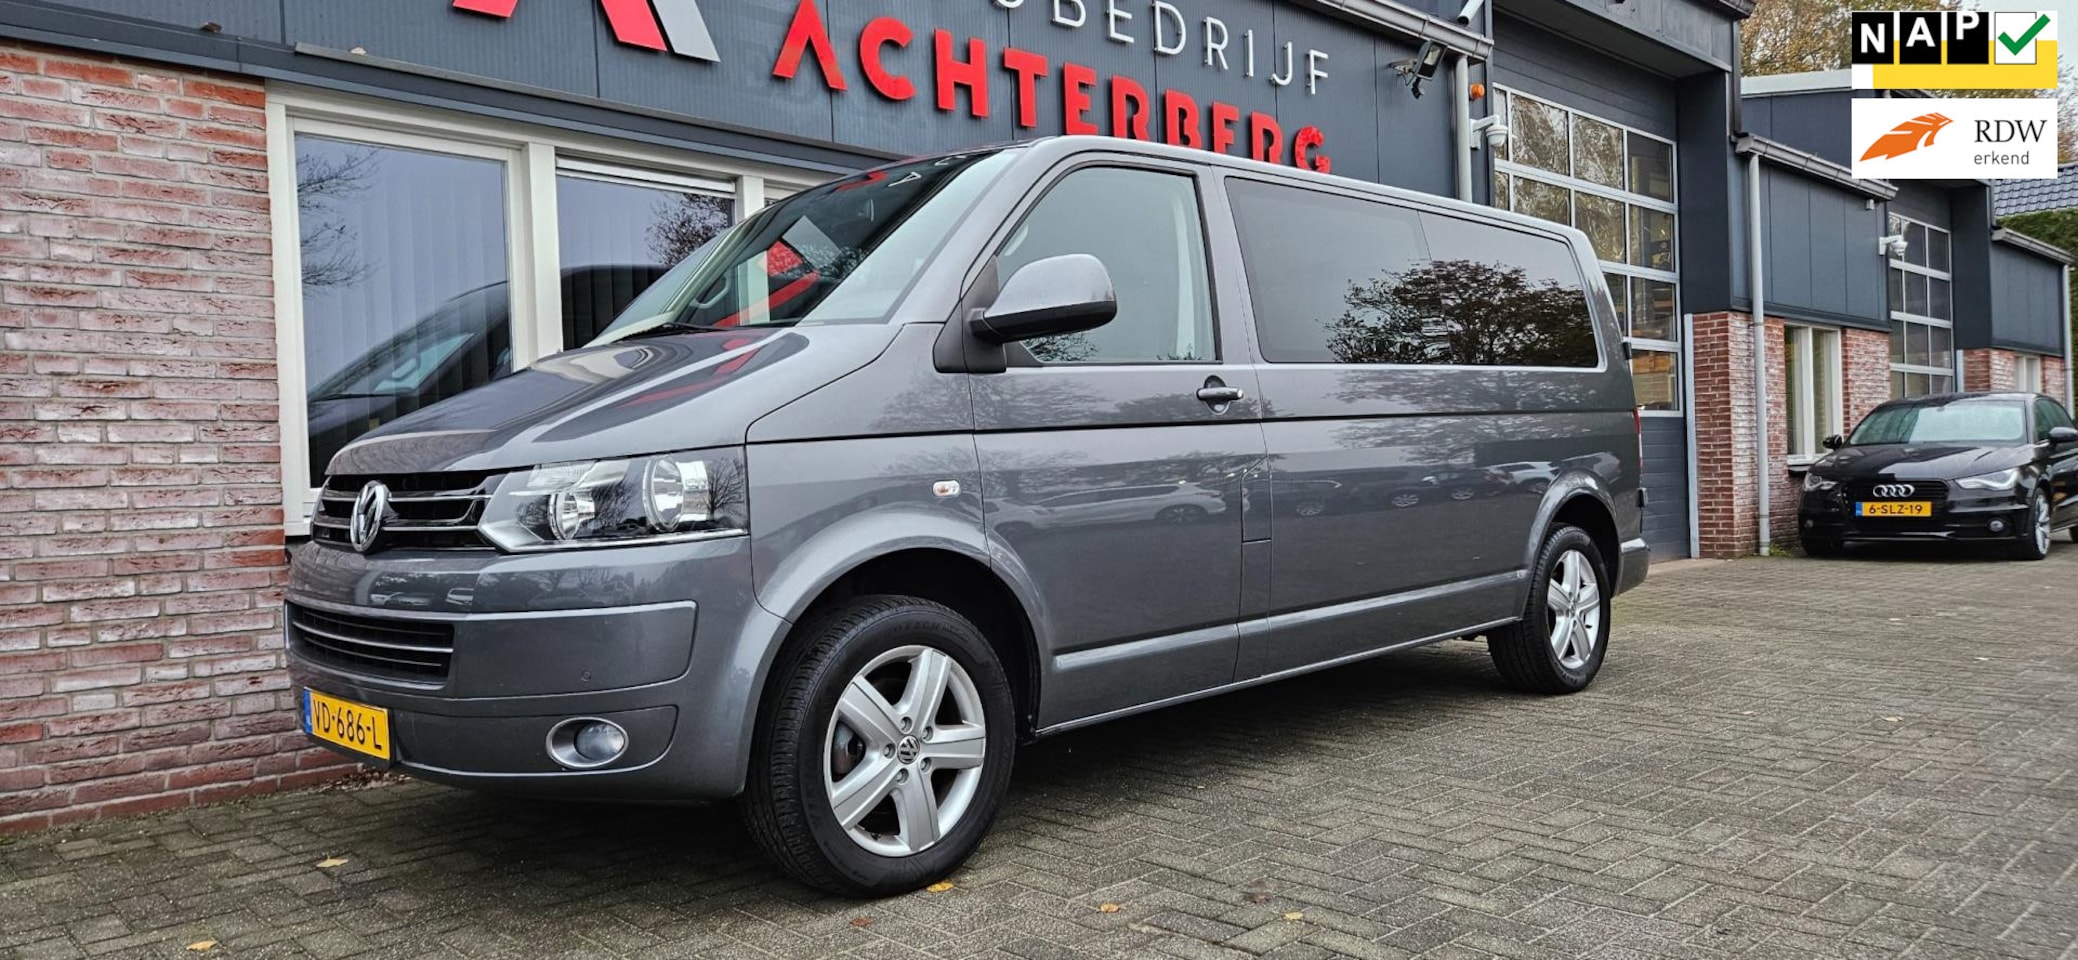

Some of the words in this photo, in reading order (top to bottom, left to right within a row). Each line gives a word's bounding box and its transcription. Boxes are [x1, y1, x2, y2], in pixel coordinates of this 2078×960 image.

[996, 0, 1329, 95] EDRIJF
[772, 0, 1332, 174] ACHTERBERG
[1868, 504, 1923, 515] 6-SLZ-19
[312, 698, 383, 751] VD-686-L
